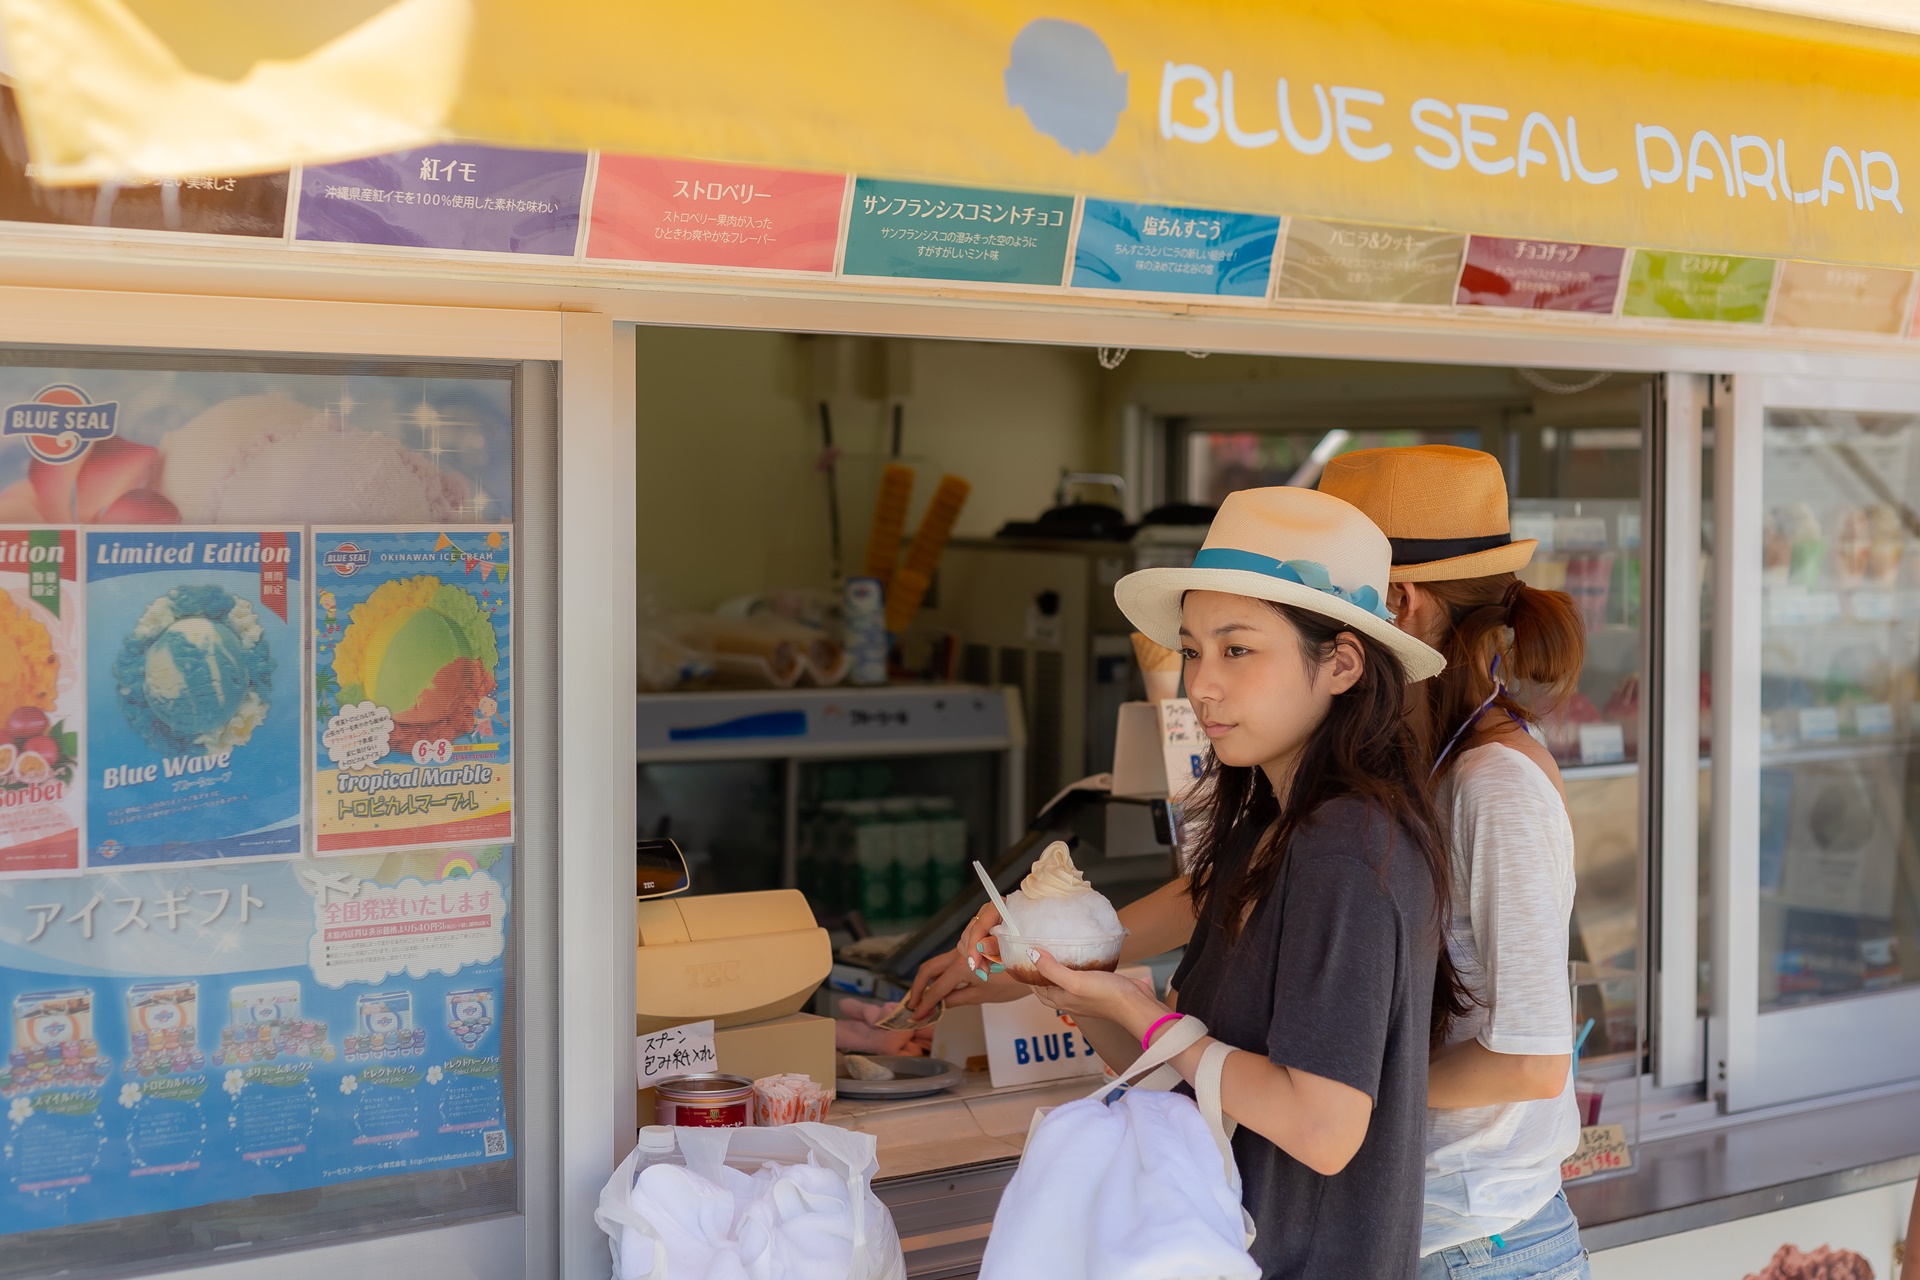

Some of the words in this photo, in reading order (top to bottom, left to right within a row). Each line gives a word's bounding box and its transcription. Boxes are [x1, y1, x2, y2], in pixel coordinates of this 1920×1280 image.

[1159, 61, 1392, 163] BLUE
[1410, 97, 1619, 185] SEAL
[419, 156, 477, 183] 紅イモ
[324, 184, 559, 214] 沖縄県産紅イモを100%使用した素朴な味わい
[672, 179, 772, 204] ストロベリー
[662, 210, 773, 231] ストロベリー果肉が入った
[862, 194, 1065, 228] サンフランシスコミントチョコ
[653, 226, 777, 245] ひときわ爽やかなフレーバー
[880, 226, 1038, 249] サンフランシスコの澄みきった空のように
[1142, 215, 1221, 241] 塩ちんすこう
[916, 244, 1001, 262] すがすがしいミント味
[1514, 239, 1582, 263] チョコチップ
[12, 410, 59, 429] BLUE
[63, 411, 110, 430] SEAL
[97, 541, 195, 564] Limited
[202, 542, 292, 564] Edition
[327, 553, 347, 562] BLUE
[348, 553, 367, 562] SEAL
[380, 553, 436, 562] OKINAWAN
[439, 552, 457, 561] ICE
[459, 552, 494, 562] CREAM
[263, 584, 284, 596] 限定
[103, 763, 159, 790] Blue
[161, 751, 232, 779] Wave
[337, 766, 418, 794] Tropical
[421, 763, 492, 788] Marble
[338, 794, 480, 820] トロピカルマーブル
[643, 881, 656, 890] TEC
[23, 882, 266, 944] アイスギフト
[323, 890, 494, 926] 全国発送いたします
[685, 960, 741, 990] TEC
[644, 1029, 687, 1054] スプーン
[1014, 1031, 1077, 1066] BLUE
[363, 1064, 416, 1078] セレクトパック
[644, 1044, 716, 1076] 包み紙入れ
